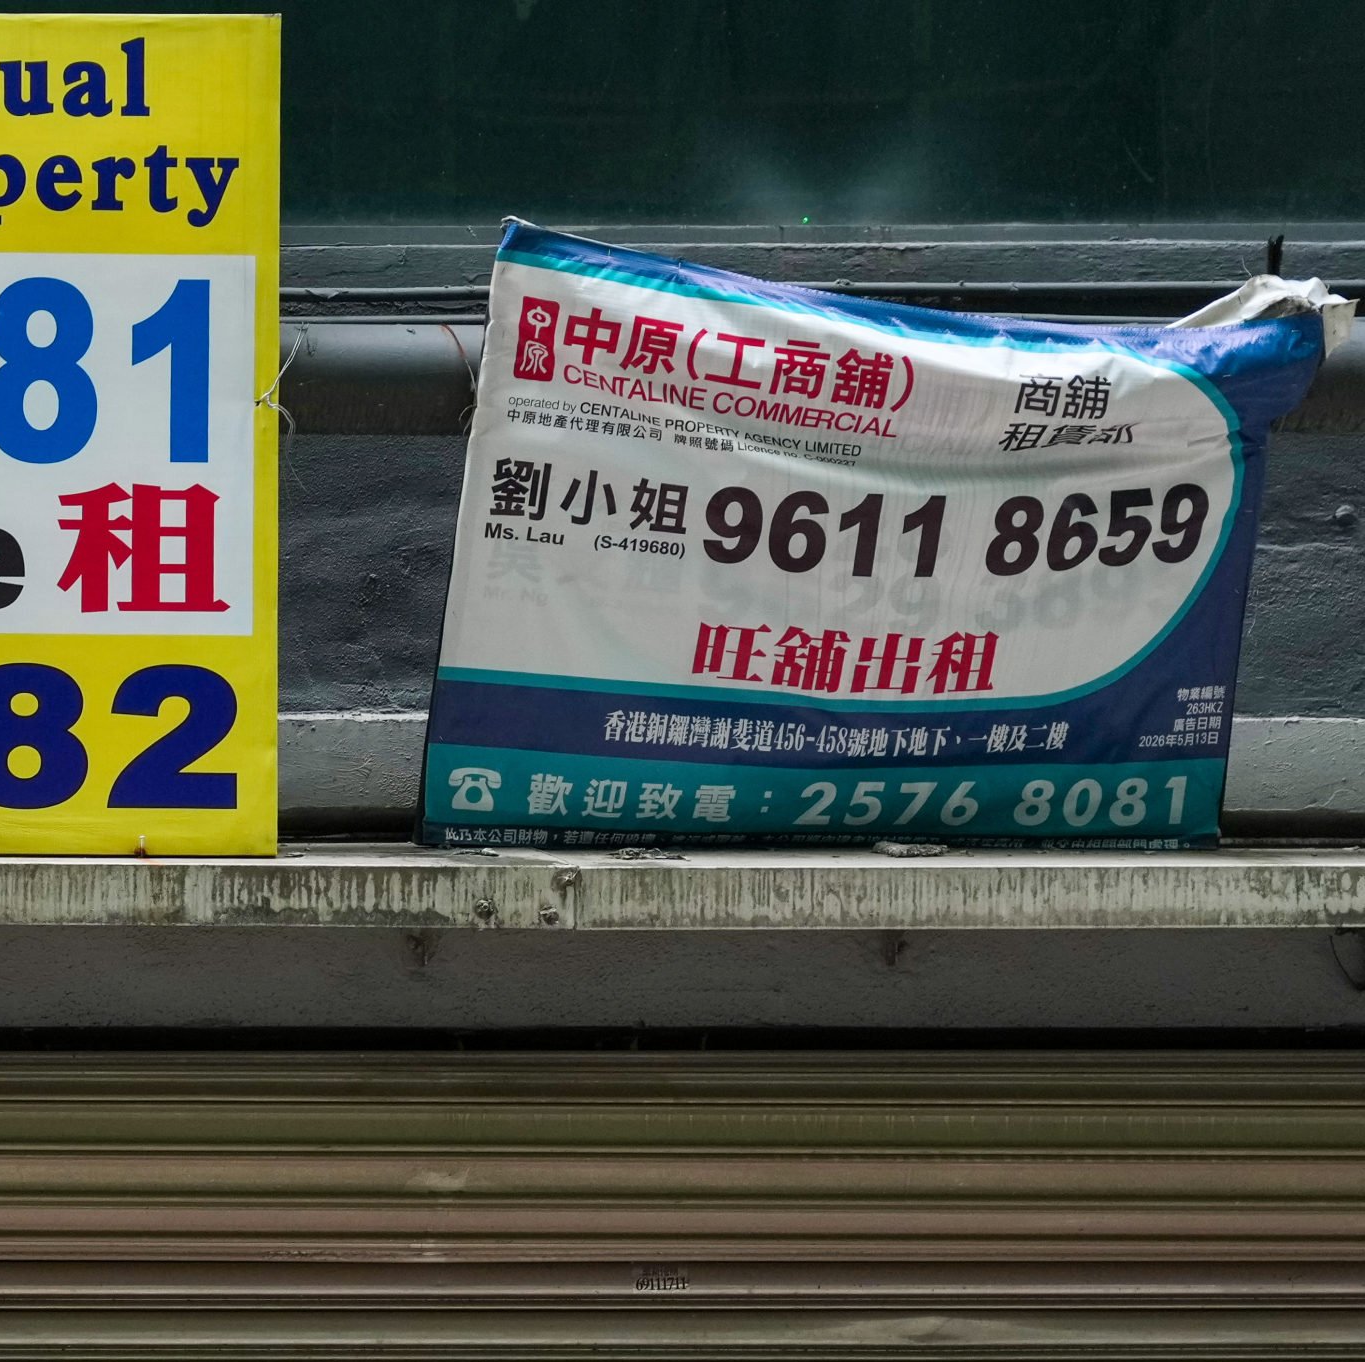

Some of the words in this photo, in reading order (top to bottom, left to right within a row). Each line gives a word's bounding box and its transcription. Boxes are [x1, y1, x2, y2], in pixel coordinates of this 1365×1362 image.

[564, 307, 915, 413] 中原(工商舖)
[564, 366, 705, 411] CENTALINE
[713, 391, 897, 438] COMMERCIAL
[1014, 375, 1111, 419] 商舖
[508, 396, 559, 411] operated
[562, 402, 577, 414] by
[580, 401, 661, 426] CENTALINE
[665, 418, 740, 439] PROPERTY
[744, 432, 801, 450] AGENCY
[805, 439, 862, 458] LIMITED
[508, 409, 663, 442] 中原地產代理有限公司
[674, 434, 734, 453] 牌照號碼
[738, 443, 781, 457] Licence
[490, 457, 689, 534] 劉小姐
[57, 482, 231, 614] 租
[484, 522, 519, 540] Ms.
[526, 526, 565, 545] Lau
[594, 534, 686, 558] (S-419680)
[703, 486, 947, 578] 9611
[985, 483, 1209, 578] 8659
[692, 622, 998, 696] 旺舖出租
[1177, 686, 1226, 701] 物業編號
[1186, 701, 1223, 715] 263HKZ
[1139, 732, 1218, 747] 2026年5月13日
[1174, 717, 1221, 732] 廣告日期
[792, 779, 980, 827] 2576
[1013, 775, 1188, 828] 8081
